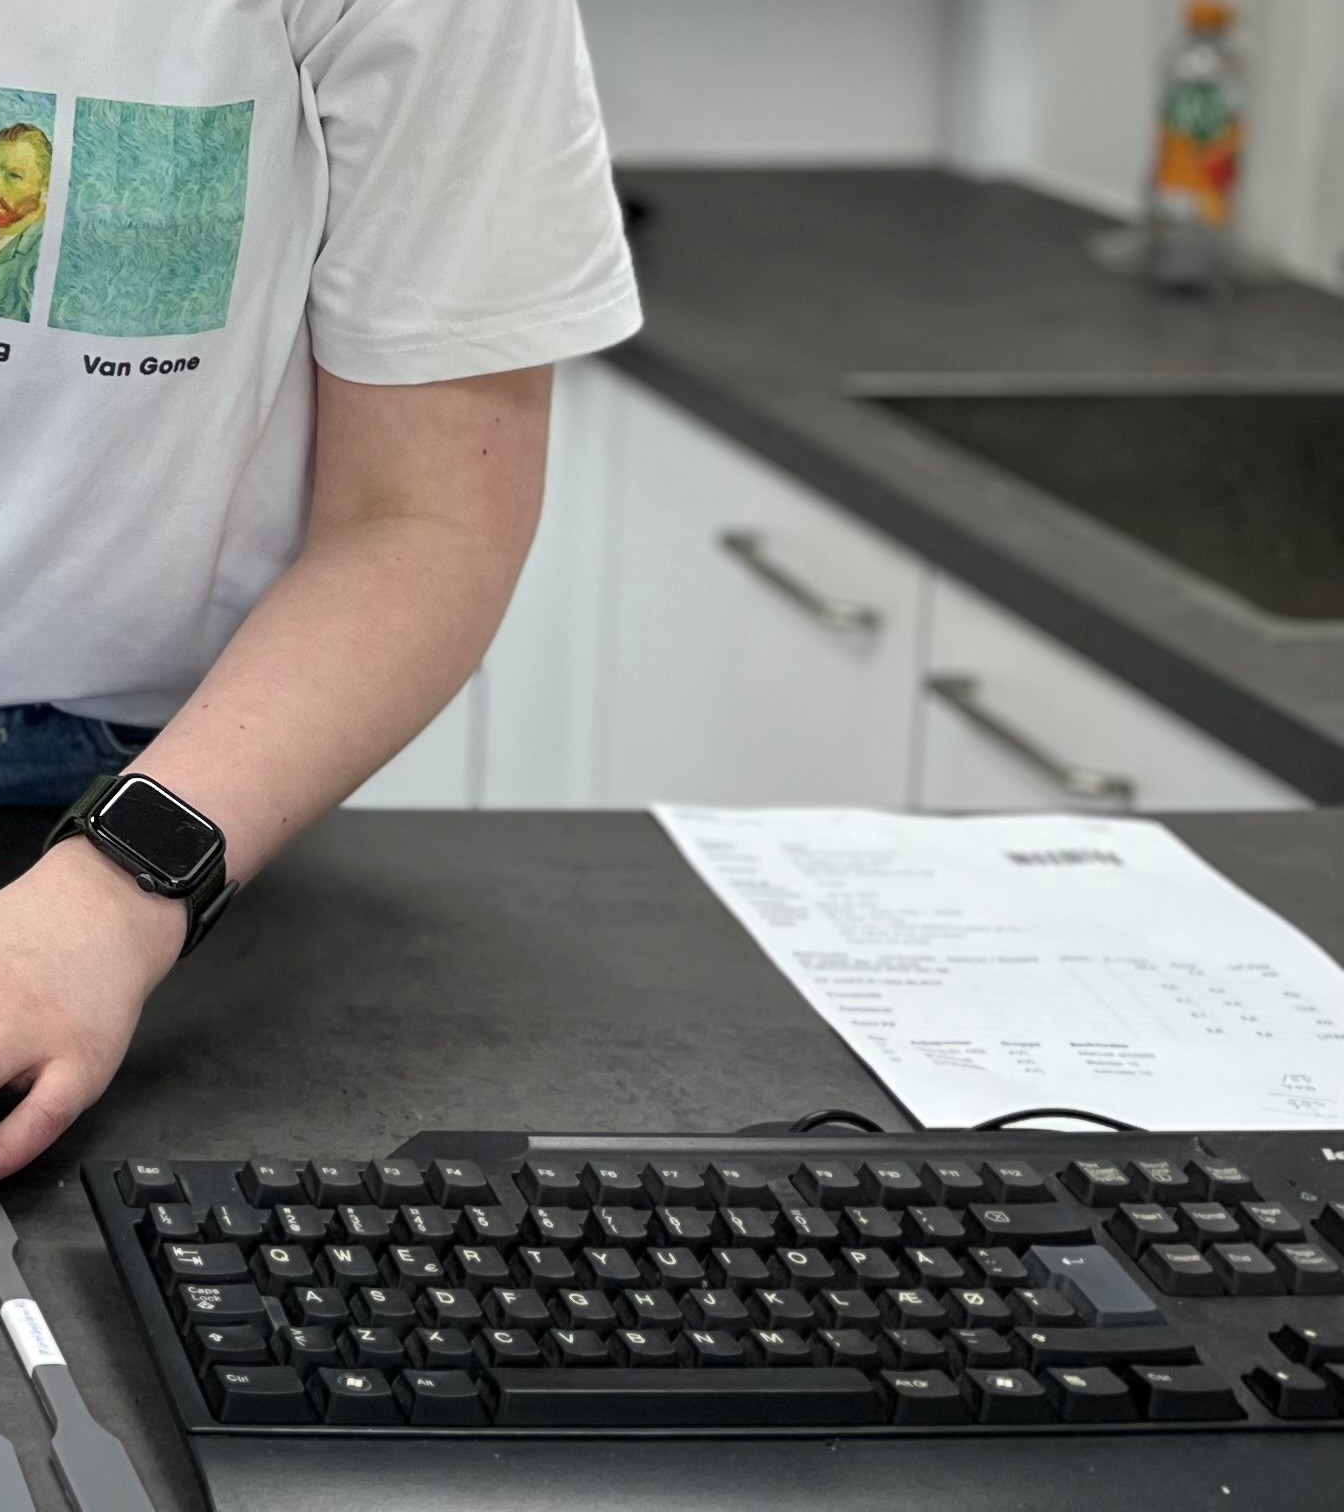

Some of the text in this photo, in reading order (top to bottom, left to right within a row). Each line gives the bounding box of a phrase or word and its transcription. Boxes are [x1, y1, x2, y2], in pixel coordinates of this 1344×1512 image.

[83, 354, 200, 376] Van Gone
[260, 1167, 275, 1175] F1
[321, 1167, 339, 1175] F2
[383, 1167, 401, 1176] F3
[445, 1168, 462, 1176] F4
[661, 1170, 678, 1178] F7
[270, 1248, 290, 1263] Q
[333, 1248, 353, 1263] W
[397, 1249, 415, 1263] E
[463, 1250, 482, 1263] R
[527, 1251, 542, 1263] T
[592, 1251, 607, 1265] Y
[657, 1251, 678, 1266] U
[721, 1252, 731, 1264] I
[787, 1251, 808, 1265] O
[850, 1251, 867, 1264] P
[424, 1263, 439, 1273] €
[188, 1286, 220, 1295] Caps
[191, 1294, 222, 1303] Lock
[306, 1290, 984, 1306] A S D F G H J K L Æ Ø
[357, 1329, 376, 1341] Z
[494, 1332, 513, 1344] C
[558, 1332, 574, 1344] V
[626, 1332, 646, 1344] B
[694, 1332, 715, 1344] N
[760, 1332, 785, 1344] M
[226, 1373, 250, 1384] Ctrl
[417, 1378, 435, 1387] Alt
